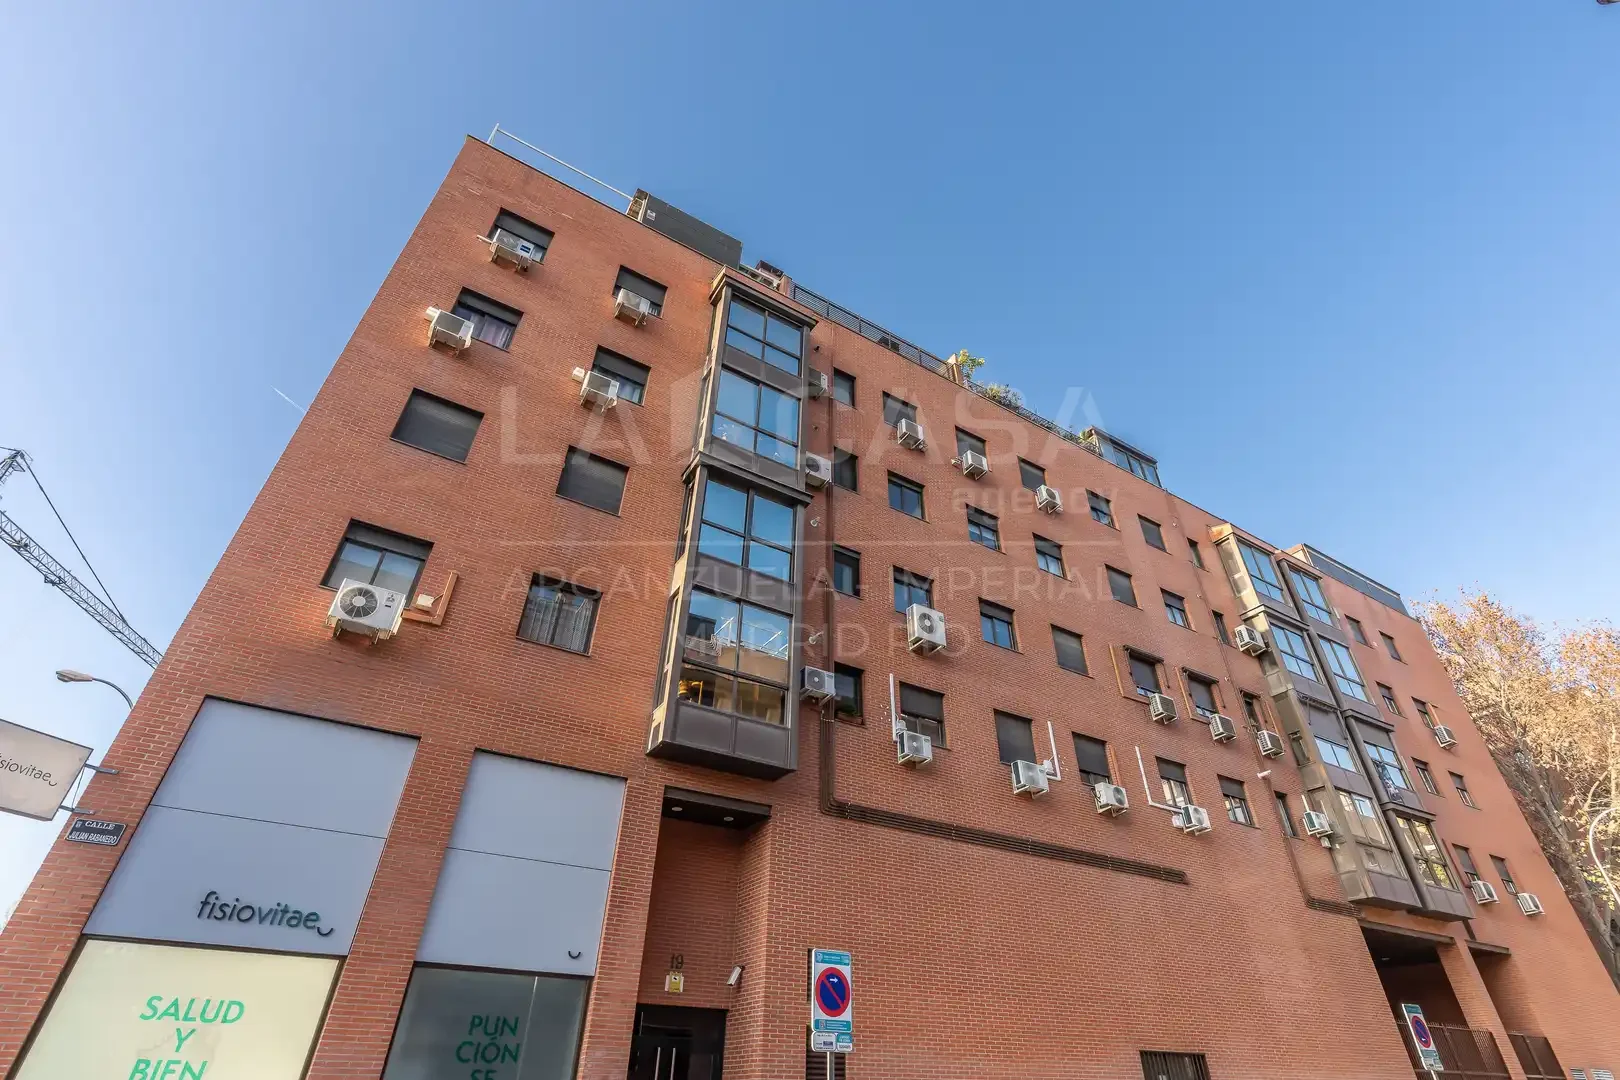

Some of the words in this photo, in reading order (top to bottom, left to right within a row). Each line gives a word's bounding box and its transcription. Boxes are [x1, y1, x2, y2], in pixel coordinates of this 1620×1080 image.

[0, 752, 52, 782] siovitae
[85, 821, 115, 830] CALLE
[197, 890, 320, 930] fisiovitae
[670, 952, 684, 969] 19
[139, 995, 245, 1024] SALUD
[468, 1014, 519, 1037] PUN
[175, 1027, 197, 1053] Y
[455, 1036, 520, 1064] CIÓN
